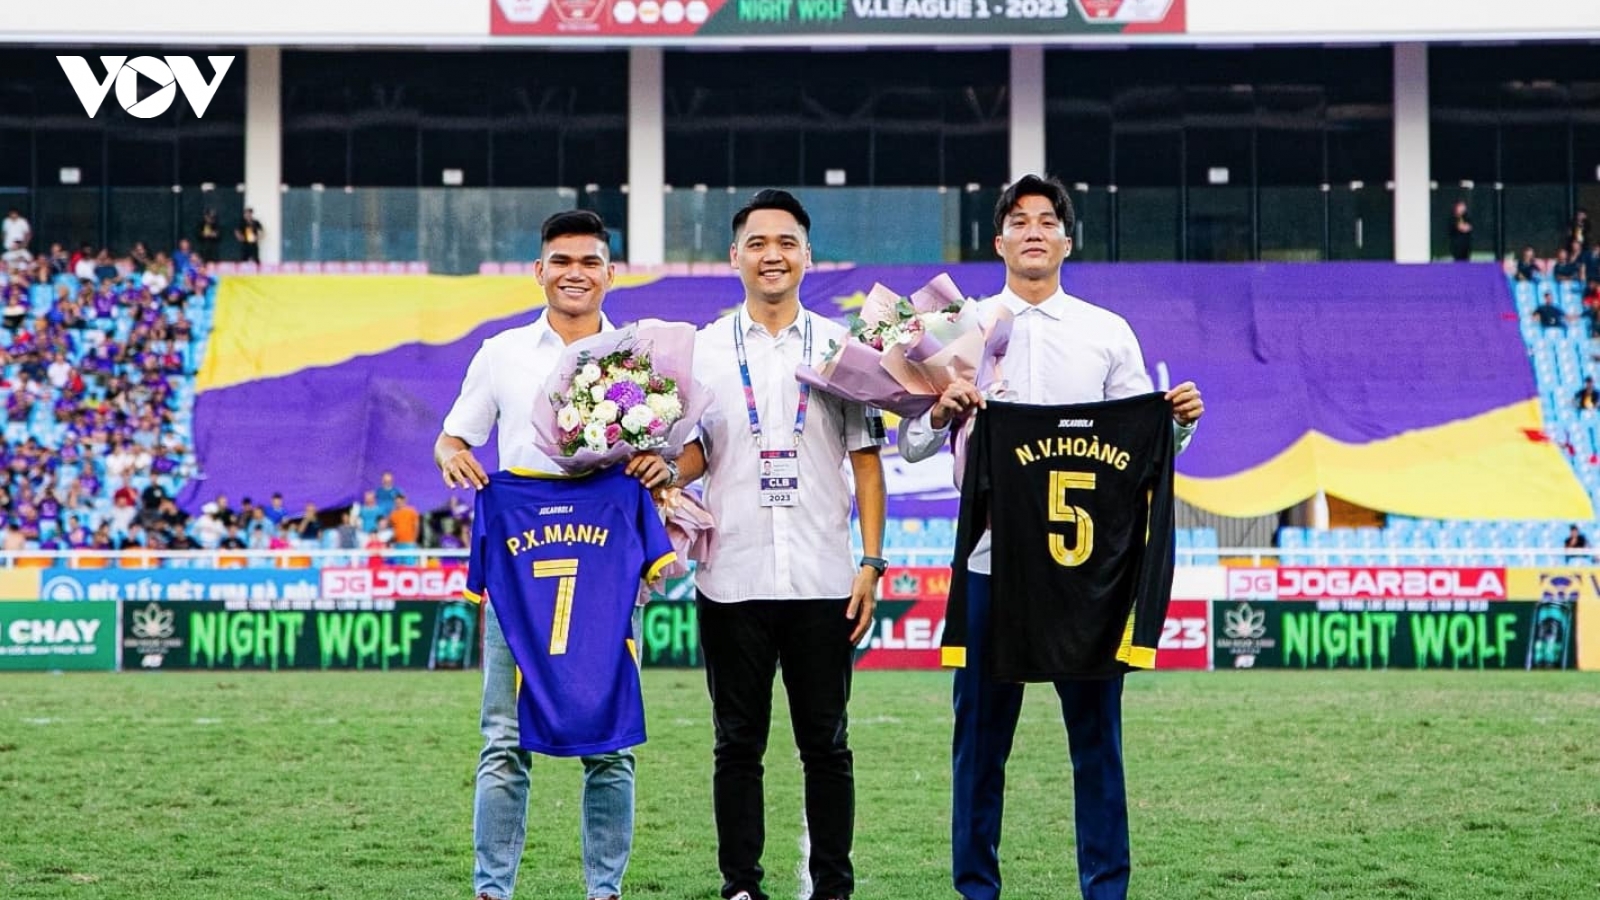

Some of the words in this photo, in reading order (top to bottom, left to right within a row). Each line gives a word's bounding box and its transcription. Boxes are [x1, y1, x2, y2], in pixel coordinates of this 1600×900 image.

[736, 0, 793, 21] NIGHT
[797, 0, 848, 21] WOLF
[852, 0, 973, 19] V.LEAGUE
[1004, 0, 1069, 19] 2023
[1015, 436, 1130, 471] N.V.HOÀNG
[769, 479, 790, 487] CLB
[1048, 470, 1096, 567] 5
[506, 523, 609, 556] P.X.MẠNH
[1279, 570, 1504, 596] JOGARBOLA
[532, 558, 579, 656] 7
[8, 618, 101, 644] CHAY
[190, 611, 305, 671] NIGHT
[316, 611, 423, 671] WOLF
[1283, 611, 1398, 671] NIGHT
[1411, 612, 1518, 671] WOLF
